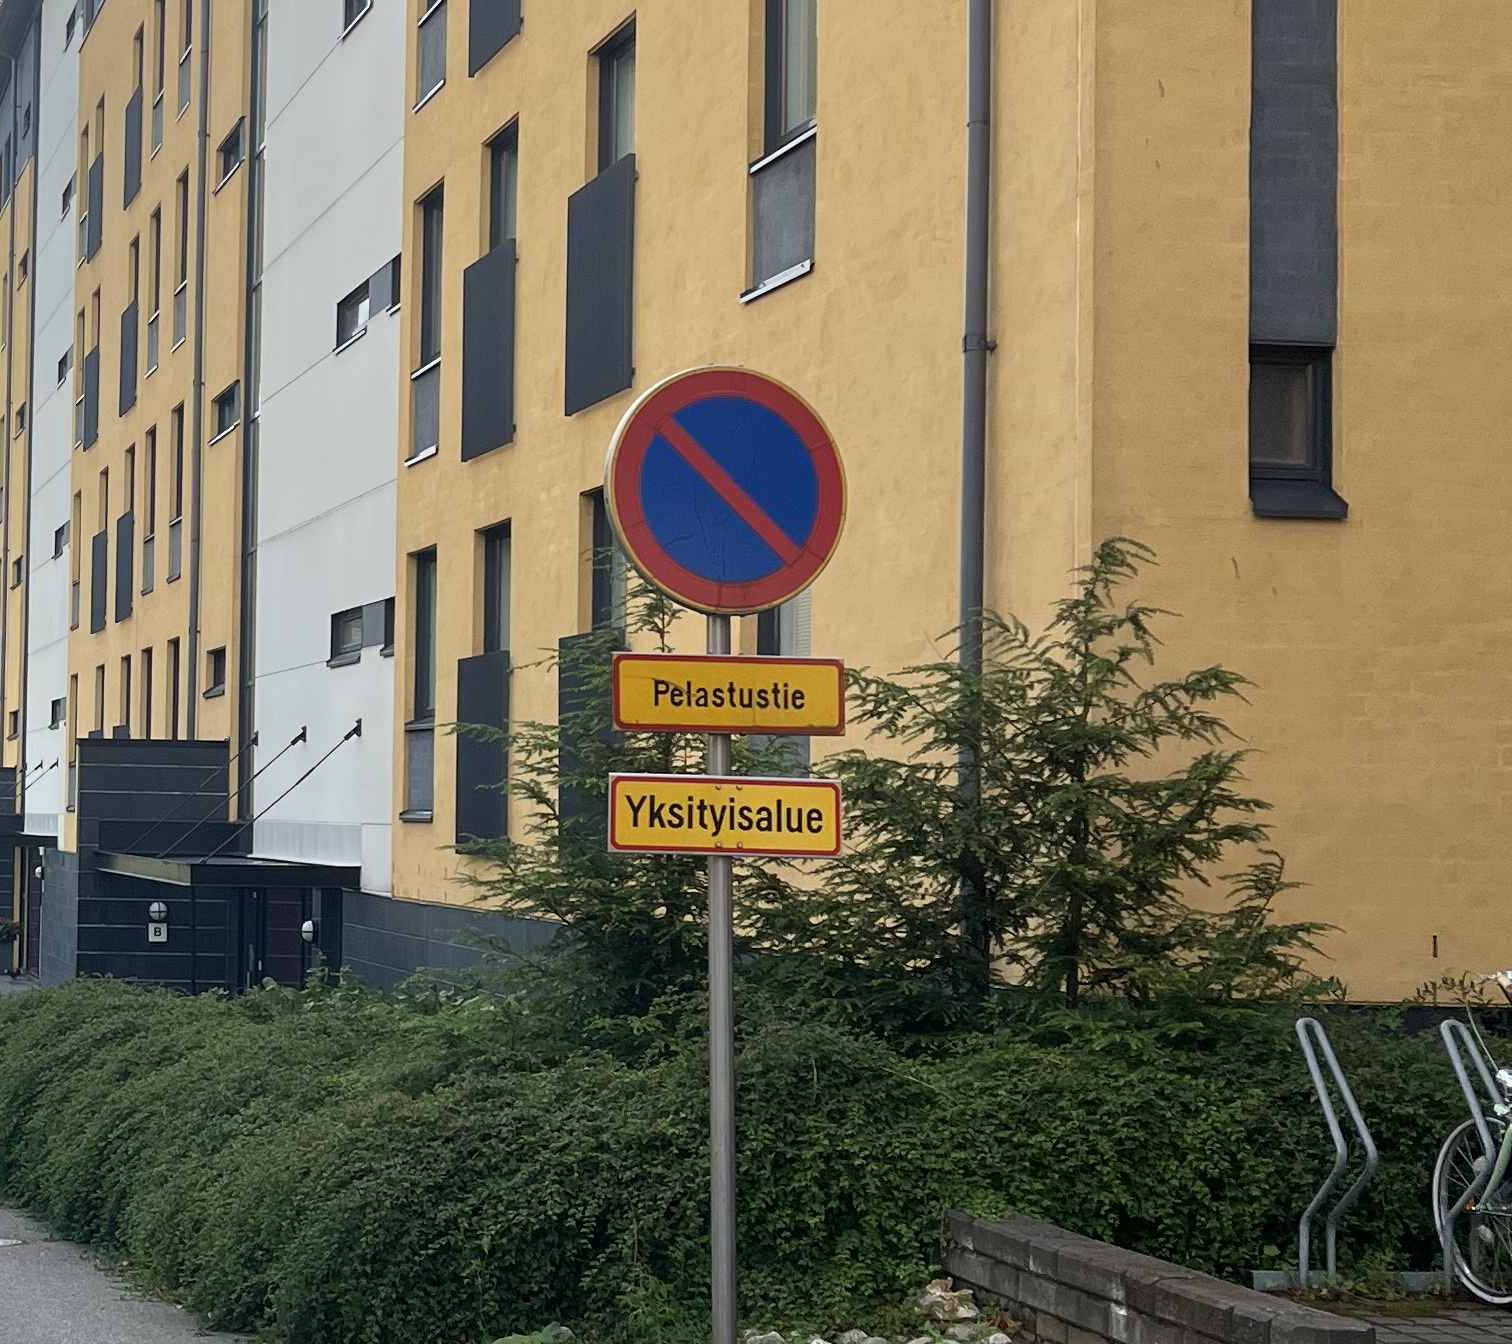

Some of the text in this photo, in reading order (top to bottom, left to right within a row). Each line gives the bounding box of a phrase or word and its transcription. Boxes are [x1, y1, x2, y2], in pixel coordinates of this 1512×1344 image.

[654, 679, 805, 710] Pelastustie
[625, 795, 823, 837] Yksityisalue
[154, 927, 162, 937] B
